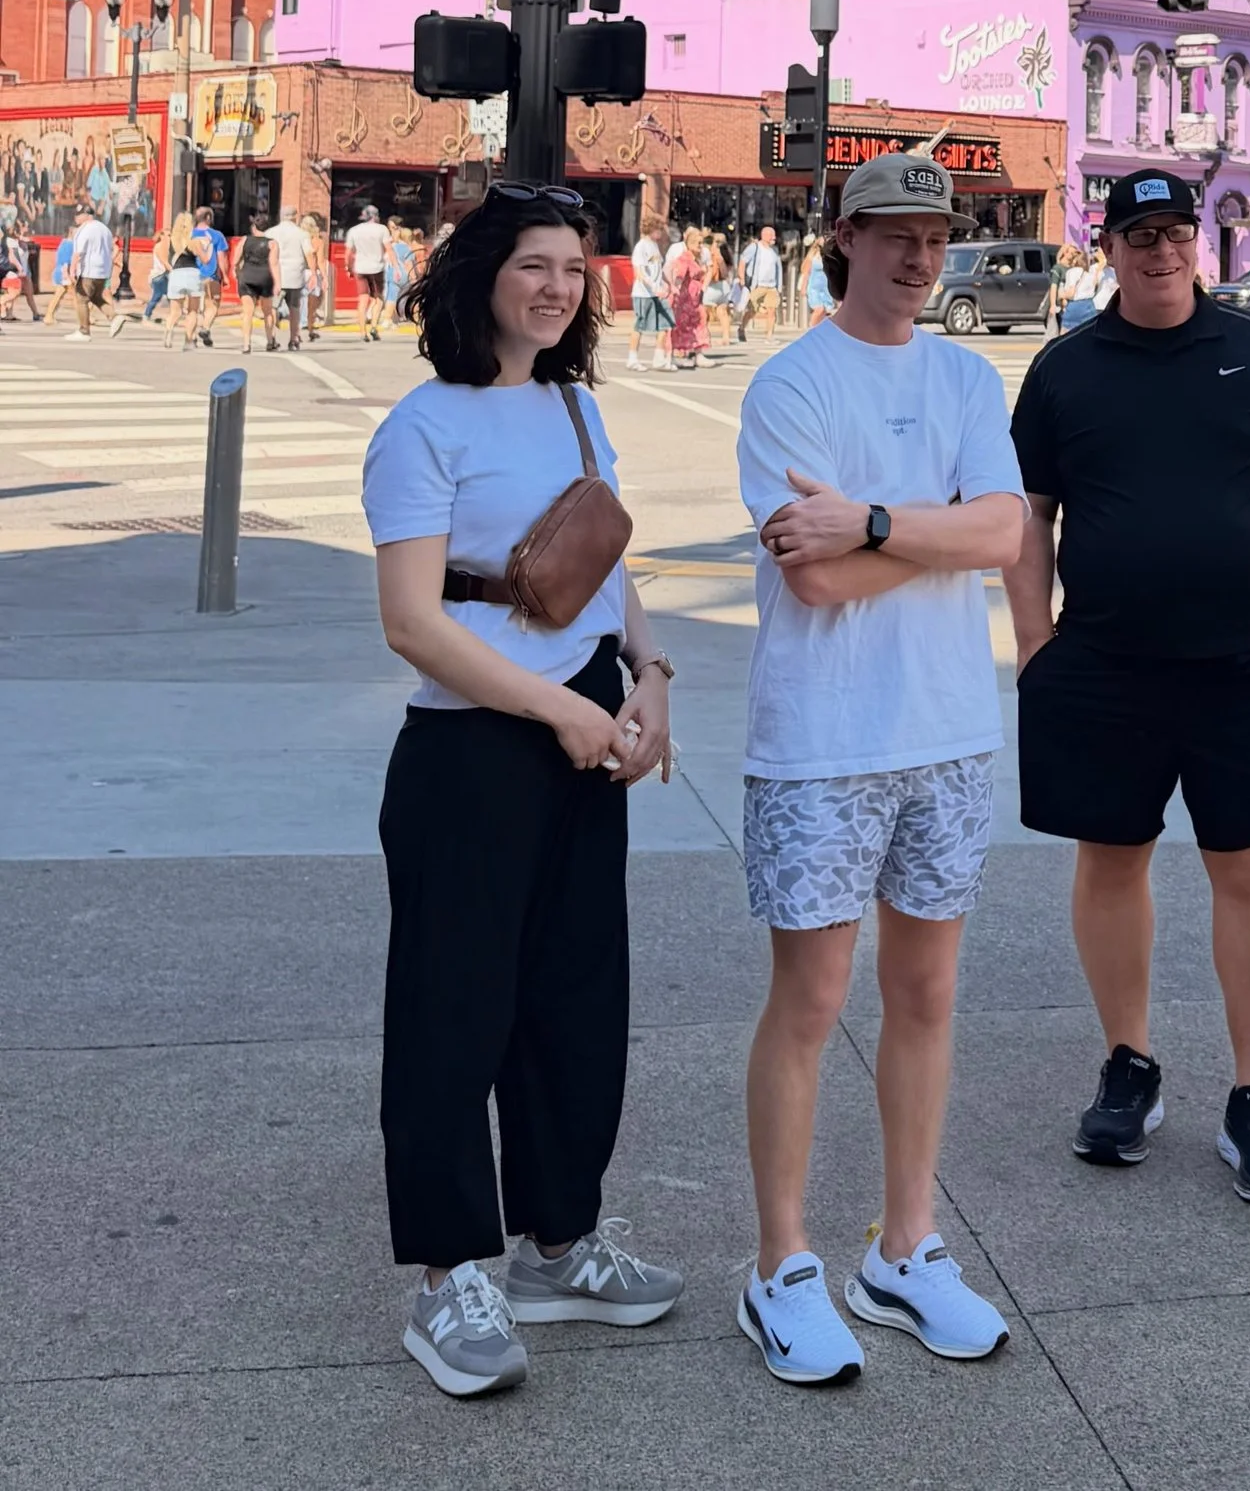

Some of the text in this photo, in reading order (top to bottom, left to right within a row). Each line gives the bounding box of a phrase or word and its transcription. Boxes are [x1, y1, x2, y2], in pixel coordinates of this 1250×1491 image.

[960, 95, 1026, 112] LOUNGE
[934, 142, 998, 171] GIFTS
[570, 1259, 615, 1293] N
